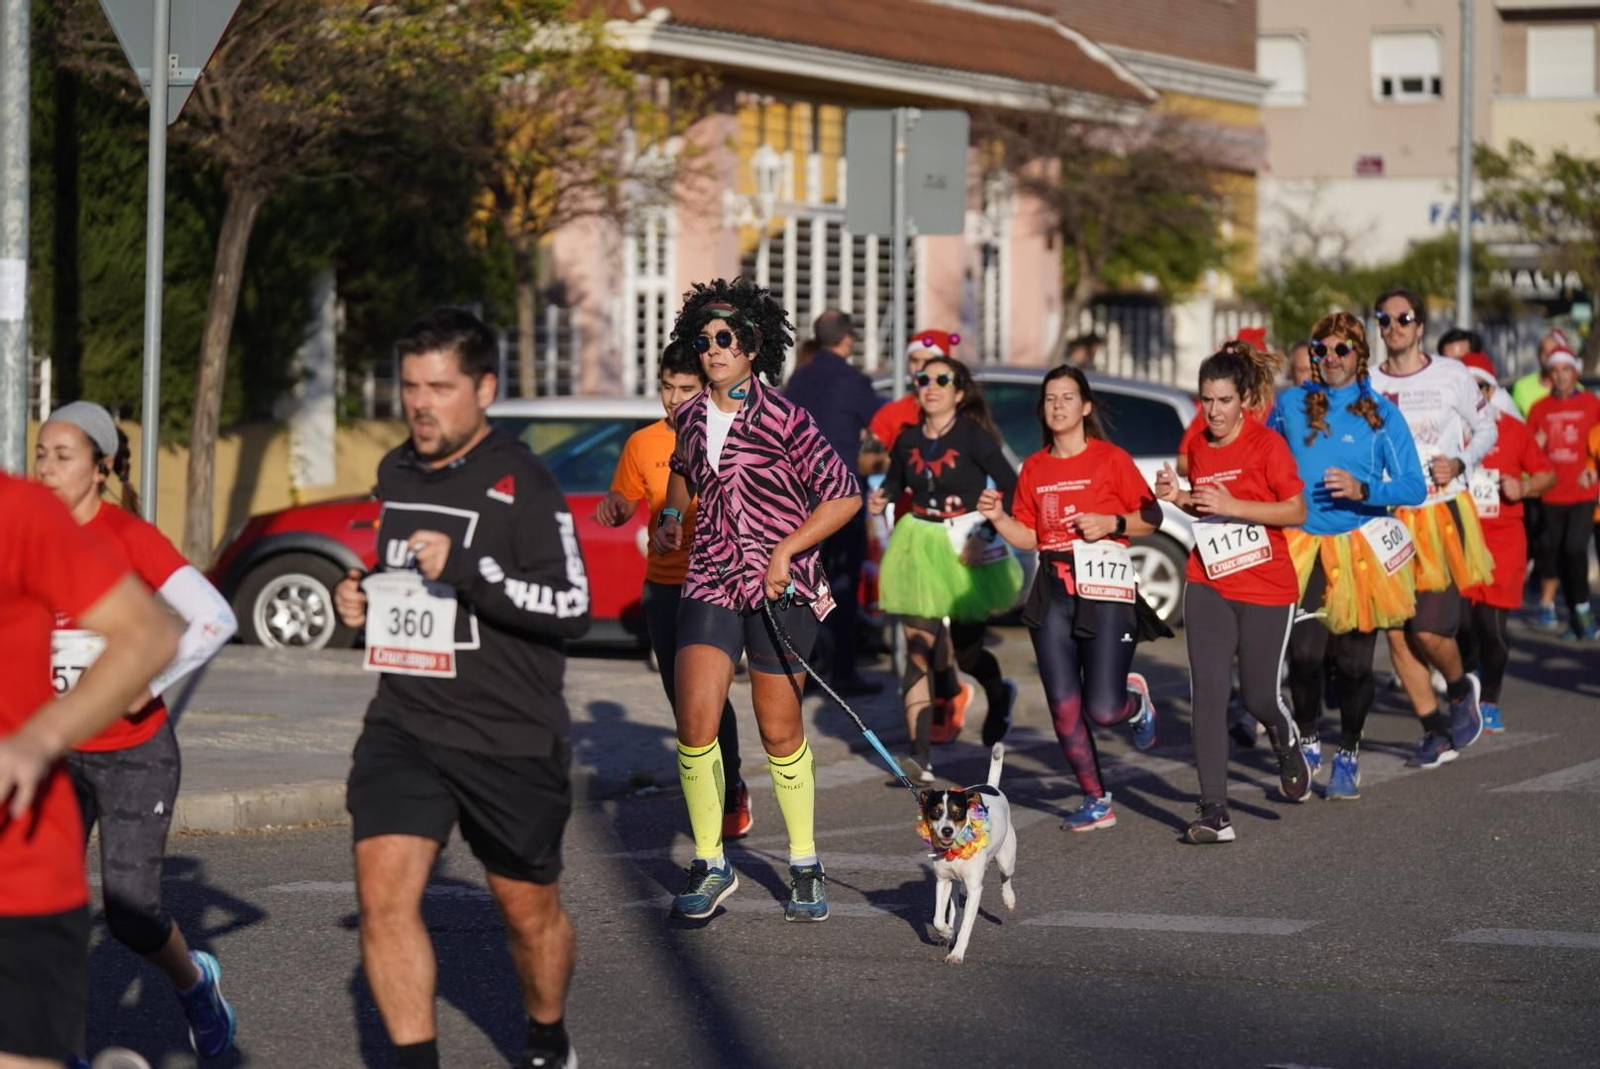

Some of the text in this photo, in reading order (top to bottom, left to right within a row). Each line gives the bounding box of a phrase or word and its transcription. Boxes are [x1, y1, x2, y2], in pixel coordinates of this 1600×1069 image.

[1208, 524, 1259, 554] 1176
[1381, 526, 1403, 551] 500
[1085, 560, 1127, 580] 1177
[1212, 550, 1261, 573] Cruzcampo
[1081, 585, 1126, 598] Cruzcampo
[388, 607, 433, 638] 360
[374, 648, 437, 669] Cruzcampo
[775, 781, 804, 791] PORTLAST
